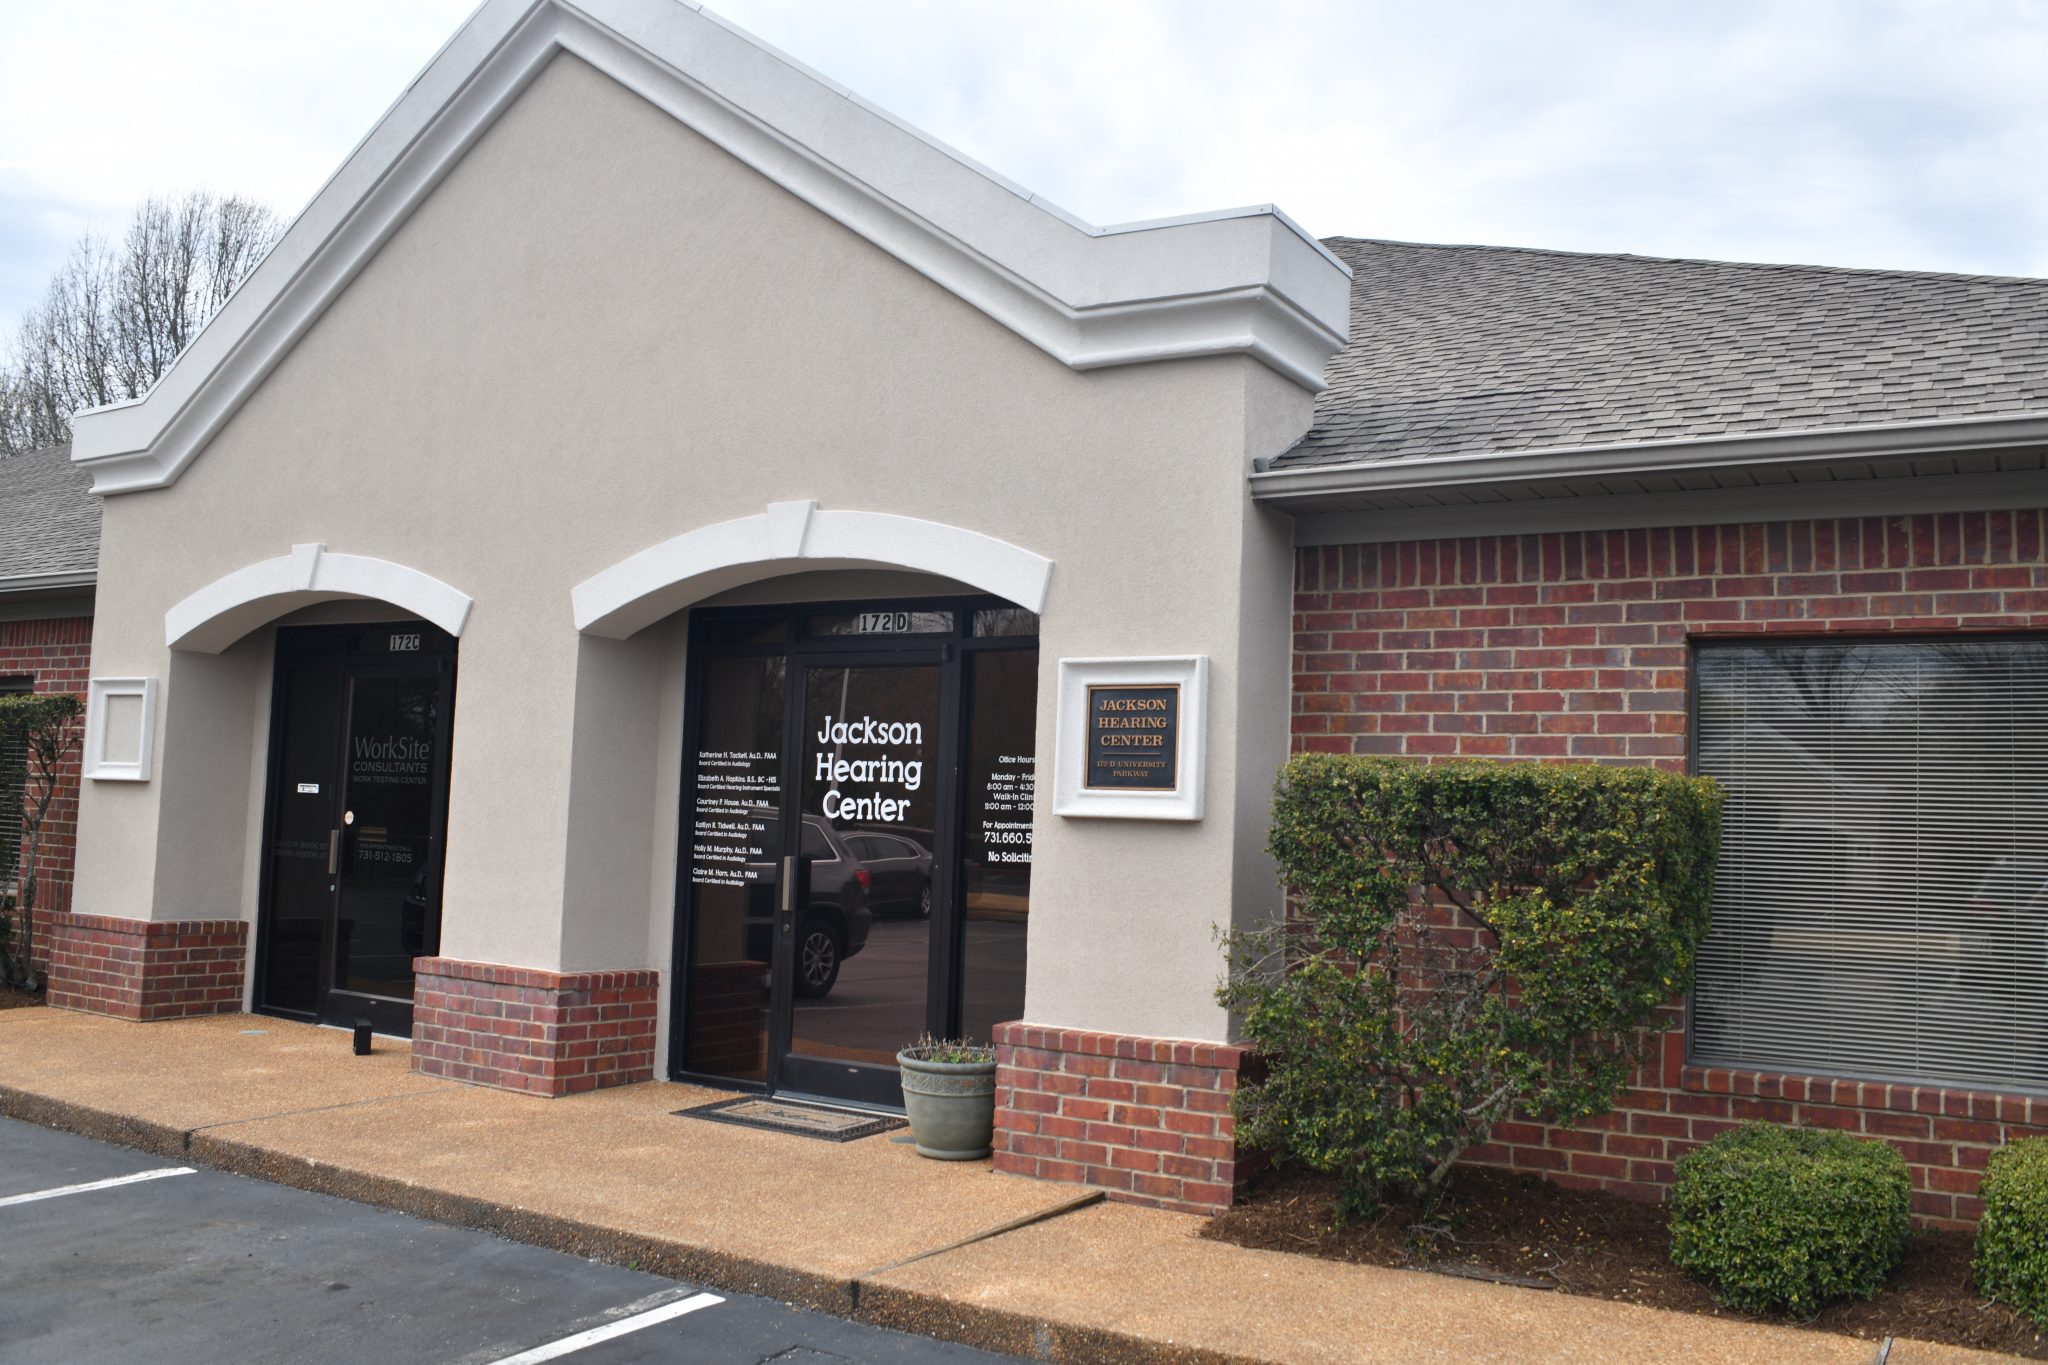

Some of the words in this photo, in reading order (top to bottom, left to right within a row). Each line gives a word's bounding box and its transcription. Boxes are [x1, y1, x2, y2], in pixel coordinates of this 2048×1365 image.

[392, 636, 419, 650] 172C
[1100, 699, 1167, 711] JACKSON
[1098, 717, 1168, 729] HEARING
[818, 715, 922, 745] Jackson
[1101, 734, 1164, 746] CENTER
[355, 735, 430, 760] WorkSite
[699, 751, 722, 759] Katherine
[764, 752, 776, 760] FAAA
[353, 761, 428, 773] CONSULTANTS
[815, 752, 923, 791] Hearing
[698, 774, 719, 782] Elizabeth
[992, 773, 1016, 781] Monday
[986, 783, 1002, 791] 8:00
[1020, 783, 1034, 791] 4:30
[697, 798, 718, 806] Courtney
[822, 789, 911, 822] Center
[752, 823, 765, 831] FAAA
[983, 821, 993, 829] For
[984, 831, 1032, 844] 731.660.5
[694, 844, 706, 852] Holly
[749, 847, 762, 855] FAAA
[988, 851, 1000, 862] No
[745, 871, 758, 879] FAAA
